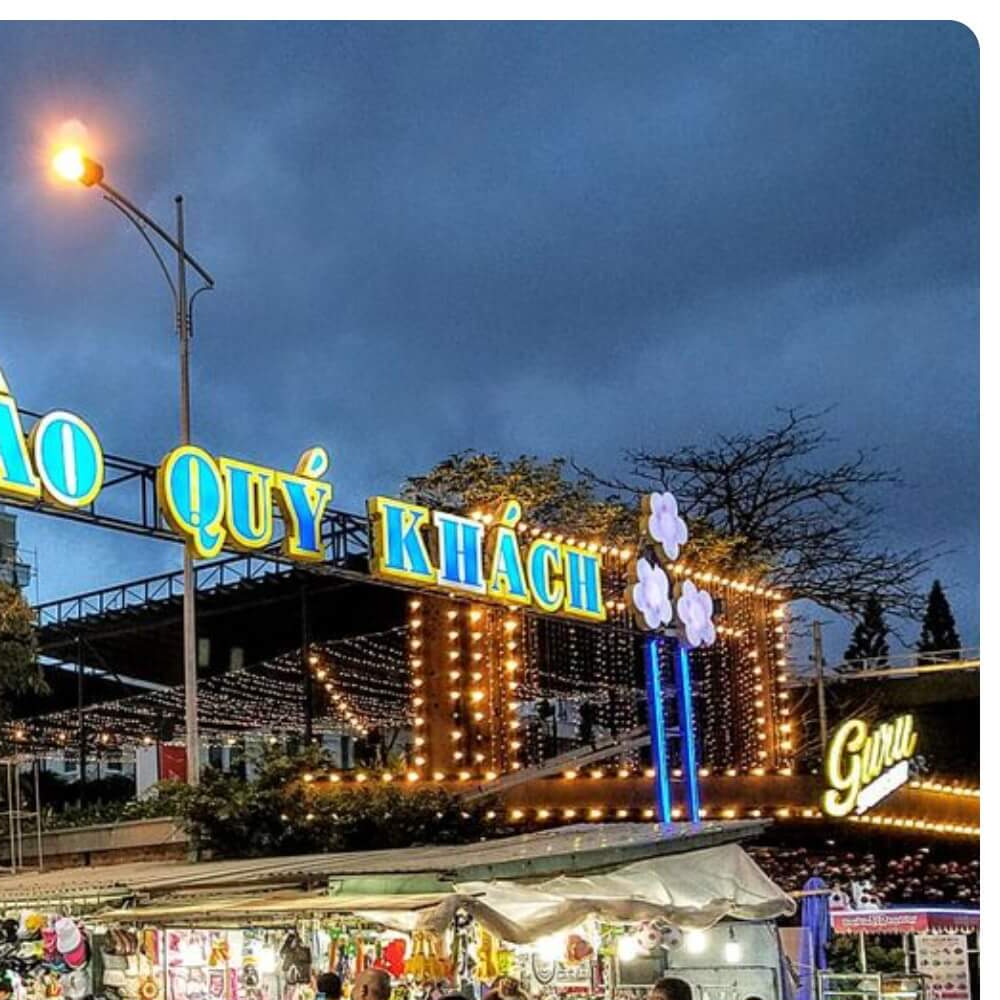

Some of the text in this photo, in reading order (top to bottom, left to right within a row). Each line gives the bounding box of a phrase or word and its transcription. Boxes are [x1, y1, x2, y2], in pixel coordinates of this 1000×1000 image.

[157, 444, 332, 561] QUÝ
[368, 497, 607, 622] KHÁCH
[824, 713, 918, 817] Guru
